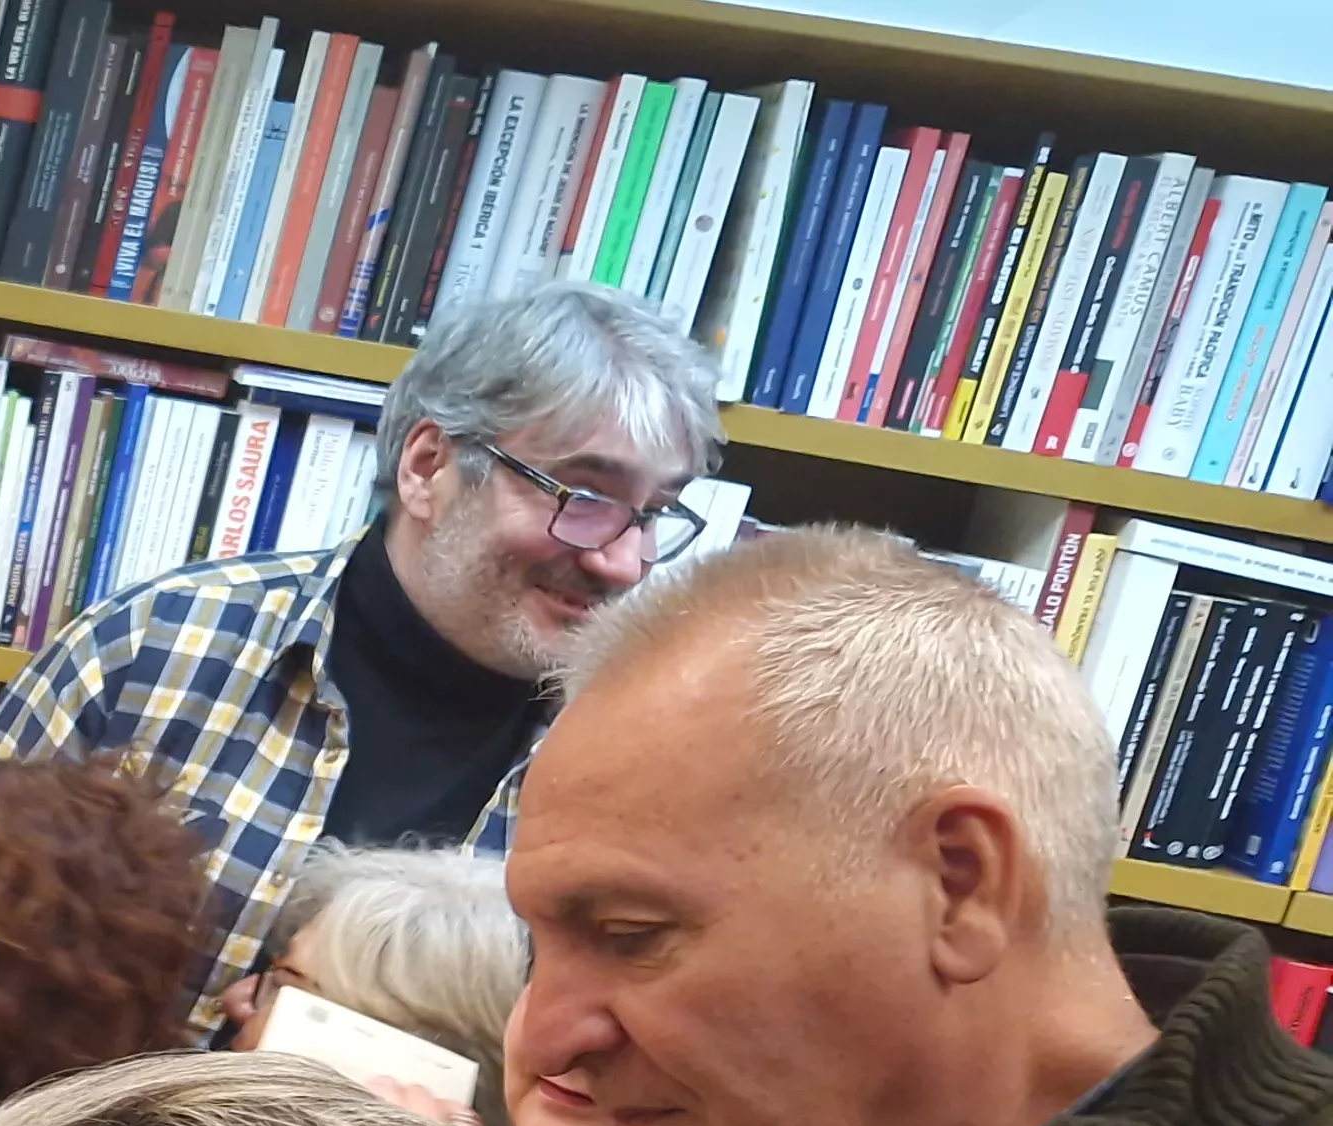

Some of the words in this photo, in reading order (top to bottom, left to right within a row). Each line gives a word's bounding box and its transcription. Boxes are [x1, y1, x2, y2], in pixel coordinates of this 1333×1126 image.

[508, 94, 525, 115] LA
[486, 112, 520, 189] EXCEPCIÓN
[128, 158, 160, 218] MAQUIS!
[472, 188, 498, 242] IBÉRICA
[1152, 175, 1186, 247] ALBERT
[123, 217, 146, 238] EL
[1241, 210, 1263, 243] MITO
[115, 239, 142, 278] ¡VIVA
[1129, 249, 1163, 319] CAMUS
[1211, 259, 1247, 331] TRANSICIÓN
[1193, 327, 1224, 383] PACÍFICA
[1165, 381, 1192, 430] BABY
[216, 492, 252, 561] ARLOS
[234, 417, 270, 493] SAURA
[13, 529, 29, 563] COSTA
[1048, 529, 1083, 595] PONTÓN
[1082, 593, 1094, 606] EL
[1086, 573, 1100, 593] FUE
